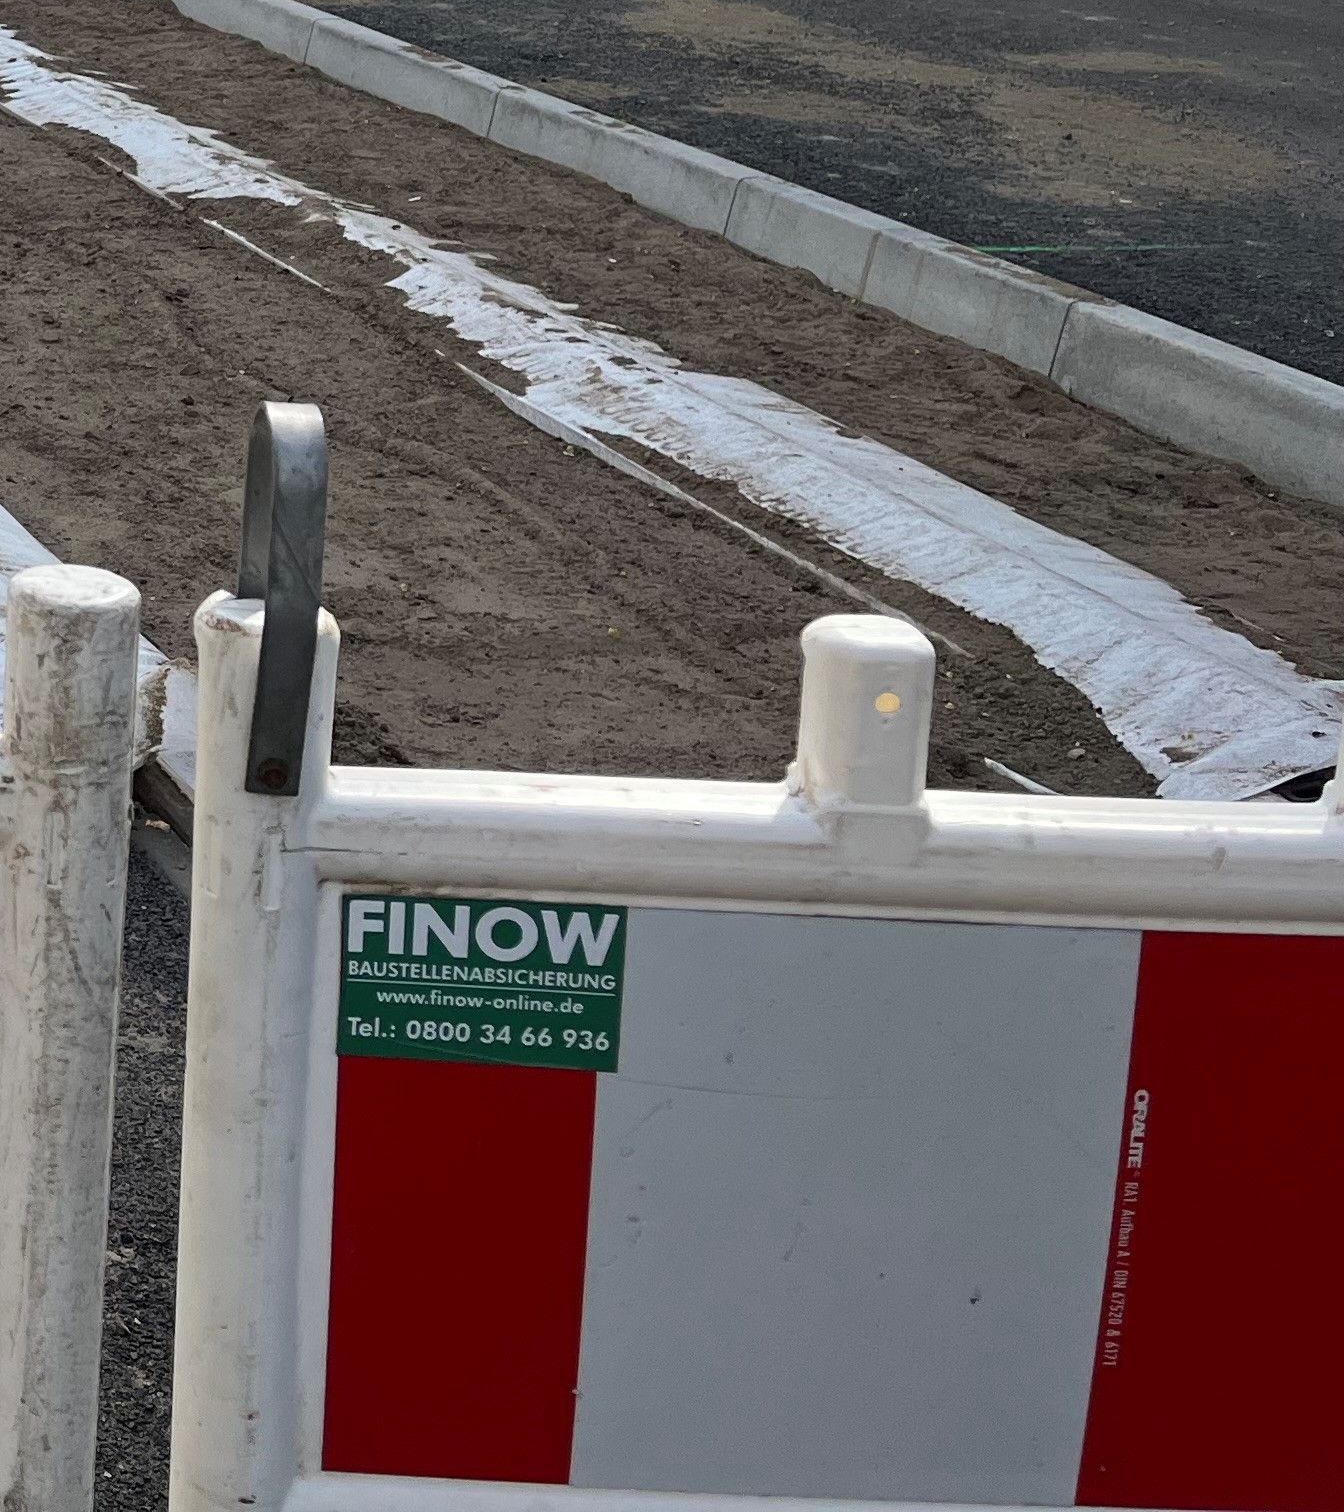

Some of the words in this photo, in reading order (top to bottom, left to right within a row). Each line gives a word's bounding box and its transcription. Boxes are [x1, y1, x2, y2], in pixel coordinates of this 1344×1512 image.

[347, 899, 620, 967] FINOW
[348, 960, 616, 990] BAUSTELLENABSICHERUNG
[376, 989, 584, 1015] www.finow-online.de
[348, 1017, 396, 1039] Tel.:
[406, 1019, 471, 1042] 0800
[479, 1024, 512, 1045] 34
[520, 1026, 553, 1047] 66
[563, 1029, 610, 1051] 936
